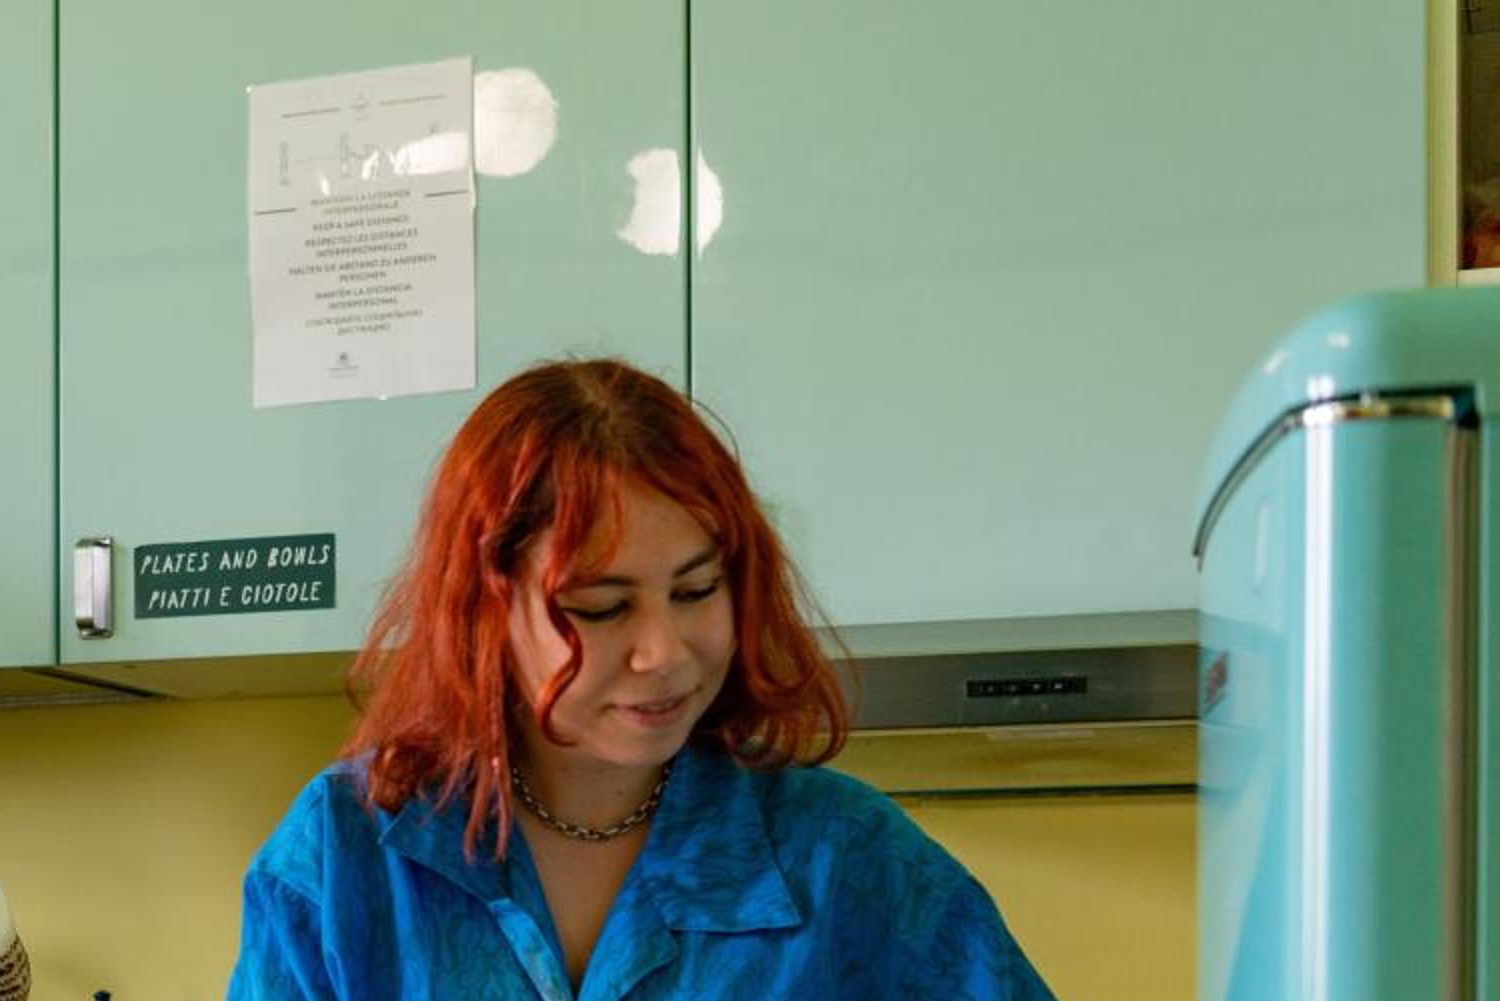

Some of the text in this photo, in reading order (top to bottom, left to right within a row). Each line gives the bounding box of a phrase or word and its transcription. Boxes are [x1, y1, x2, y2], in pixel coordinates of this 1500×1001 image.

[139, 544, 330, 576] PLATES AND BOWLS
[148, 581, 323, 611] PIATTI E CIOTOLE
